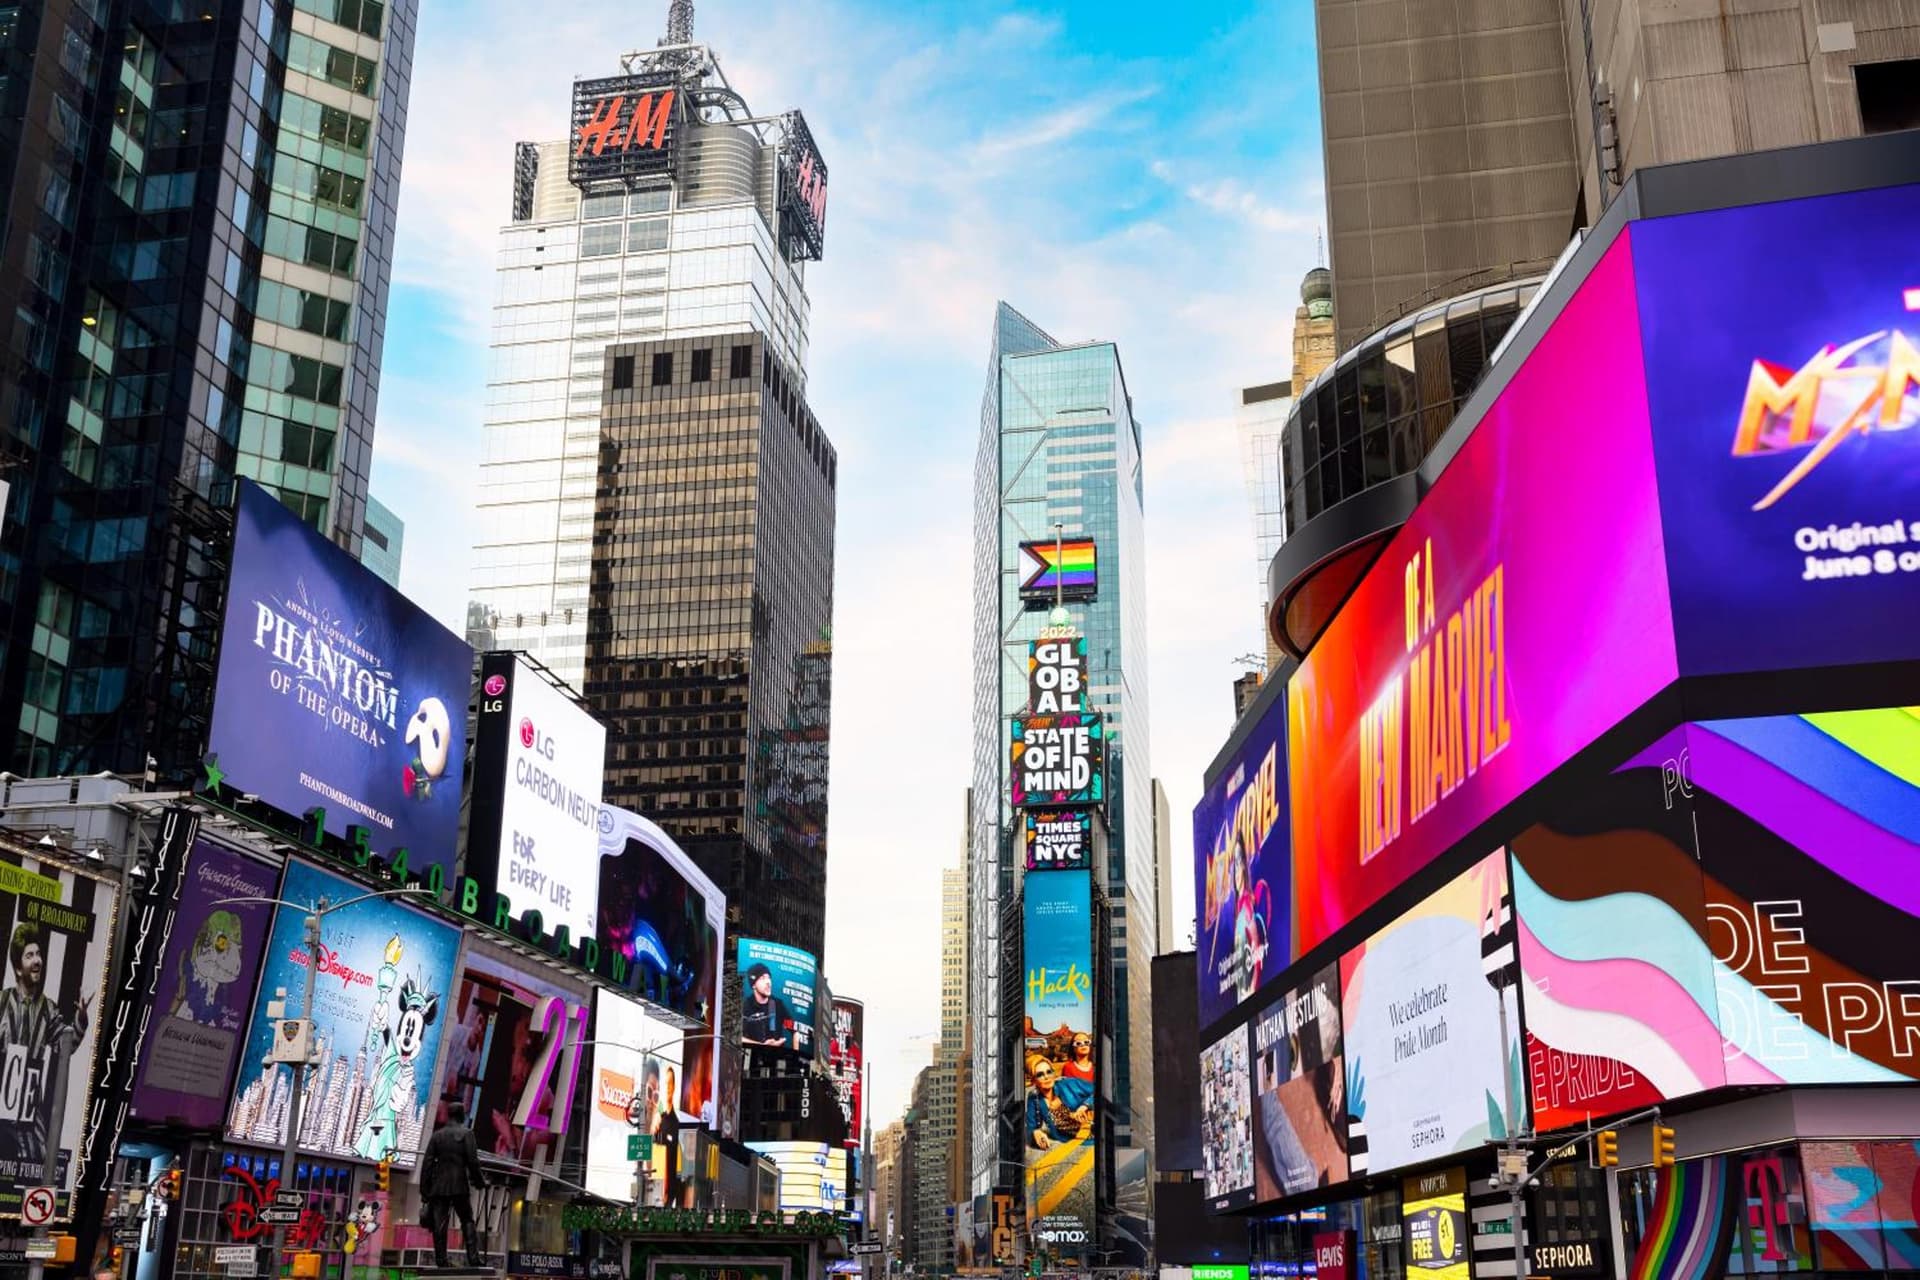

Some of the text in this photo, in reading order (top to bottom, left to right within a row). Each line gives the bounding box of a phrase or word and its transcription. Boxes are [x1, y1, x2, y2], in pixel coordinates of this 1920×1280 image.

[1794, 518, 1907, 553] Original
[1802, 555, 1872, 581] June
[1873, 549, 1897, 574] 8
[1405, 537, 1436, 653] OF A
[286, 600, 319, 626] ANDREW
[1040, 626, 1077, 640] 2022
[253, 600, 400, 730] PHANTOM
[270, 669, 380, 748] OF THE OPERA
[484, 700, 503, 713] LG
[1360, 563, 1512, 866] NEW MARVEL
[536, 729, 555, 761] LG
[1024, 727, 1090, 762] STATE
[1024, 745, 1060, 770] OF
[516, 756, 566, 812] CARBON
[1024, 756, 1090, 792] MIND
[300, 772, 394, 830] PHANTOMBROADWAY.COM
[1035, 821, 1082, 834] TIMES
[1035, 834, 1082, 846] SQUARE
[303, 807, 445, 898] 1540
[513, 829, 537, 865] FOR
[1035, 843, 1082, 861] NYC
[510, 859, 571, 912] EVERY LIFE
[26, 901, 88, 932] ON BROADWAY!
[326, 927, 355, 948] VISIT
[1028, 963, 1091, 1003] Hacks
[1255, 982, 1328, 1051] NATHAN WESTLING
[1388, 983, 1448, 1029] We celebrate
[1393, 1015, 1448, 1063] Pride Month
[514, 996, 590, 1136] 21
[801, 1079, 810, 1118] 1500
[1412, 1127, 1445, 1149] SEPHORA
[263, 1211, 296, 1221] ONE WAY
[532, 1256, 546, 1268] POLO
[1412, 1238, 1433, 1259] FREE
[1536, 1244, 1593, 1269] SEPHORA
